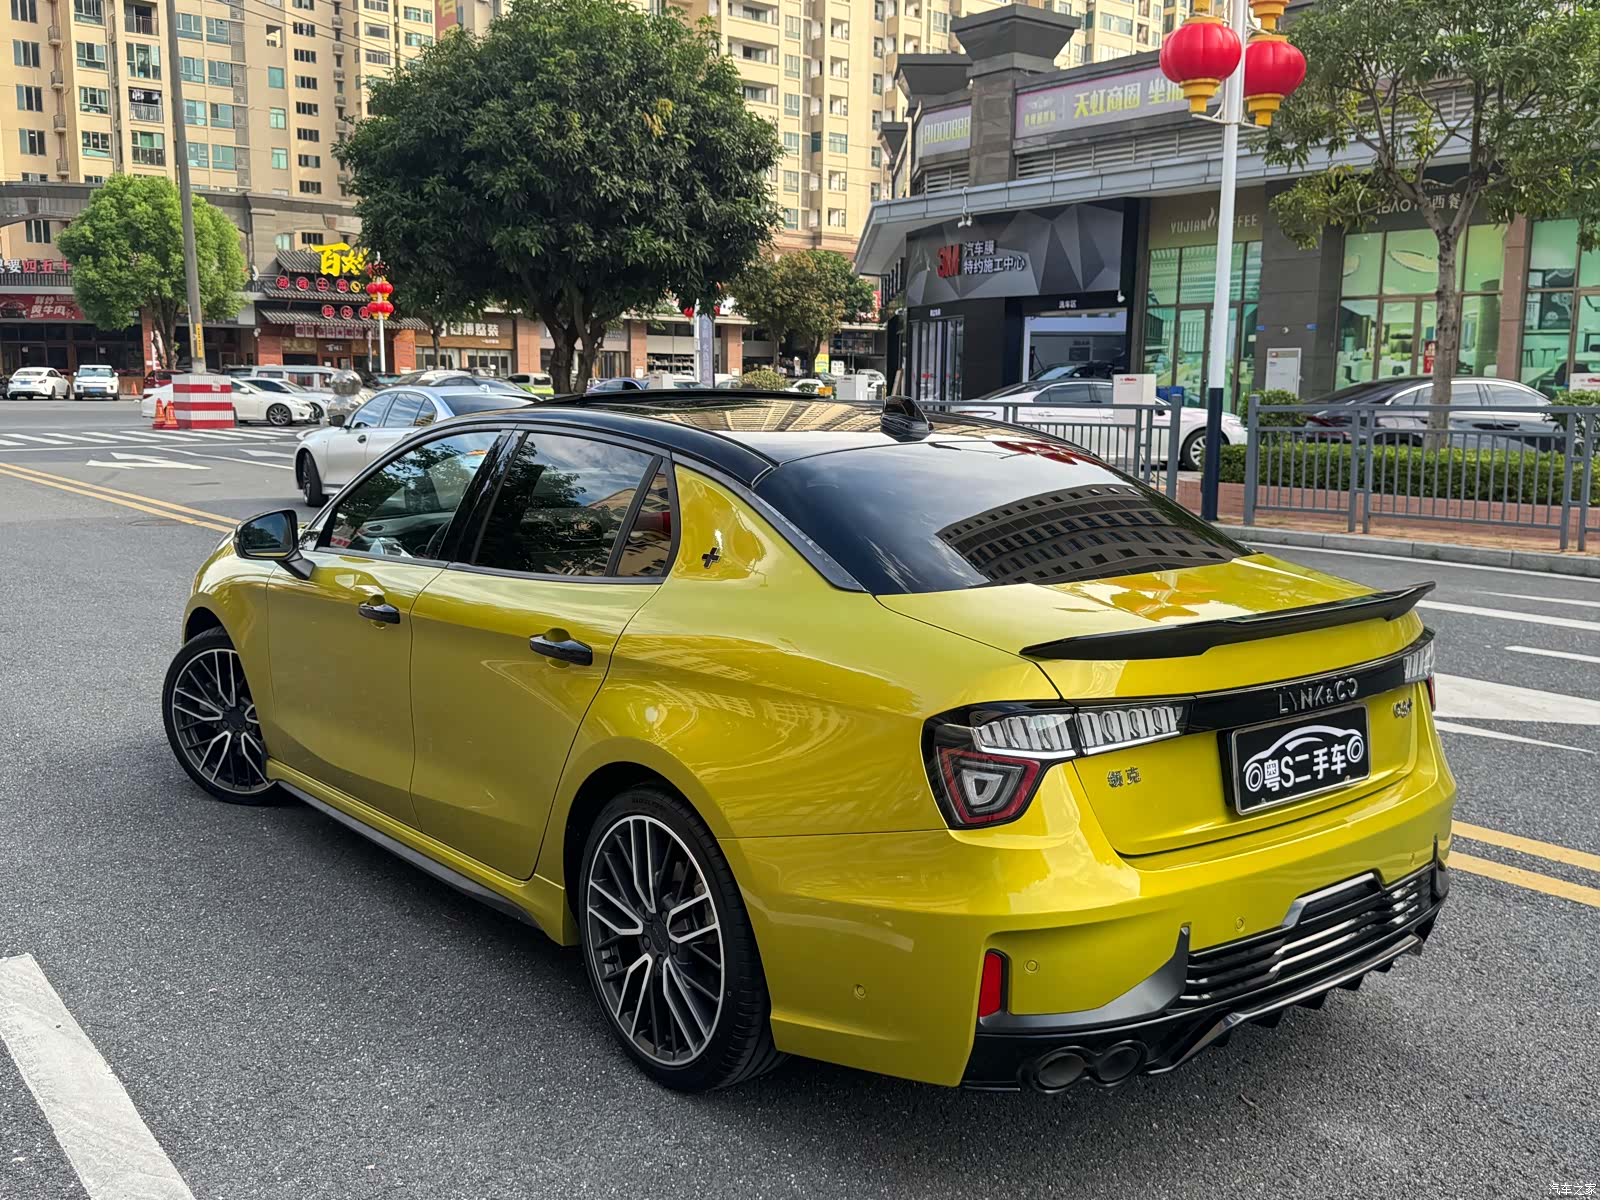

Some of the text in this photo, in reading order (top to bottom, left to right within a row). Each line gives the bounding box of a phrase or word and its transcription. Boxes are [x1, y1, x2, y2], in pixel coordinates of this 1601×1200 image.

[964, 239, 996, 257] 汽车膜
[937, 243, 961, 279] 3M
[963, 256, 1026, 275] 特约施工中心
[1279, 677, 1359, 715] LYNK&CO
[1107, 766, 1142, 788] 领克
